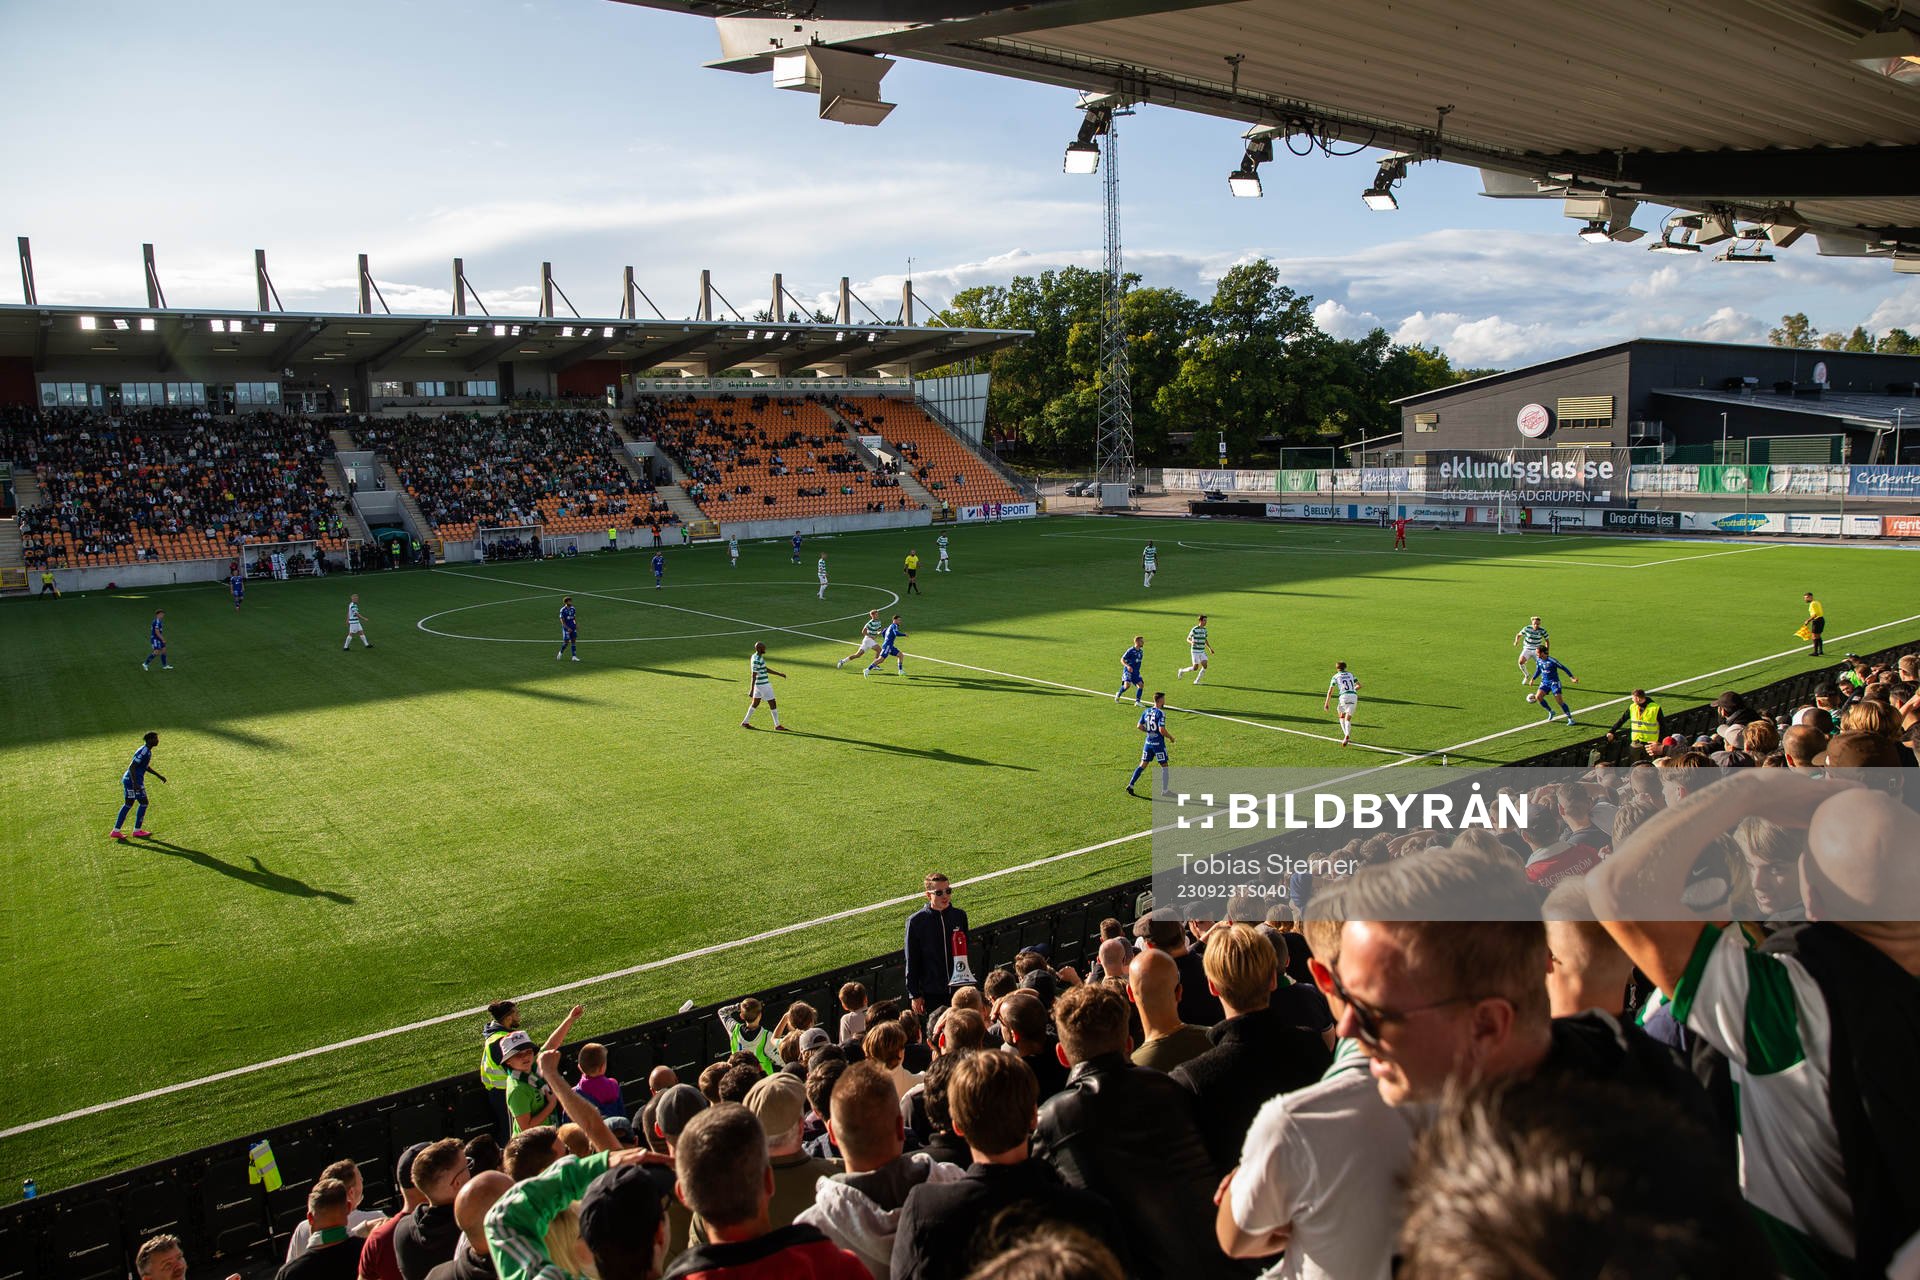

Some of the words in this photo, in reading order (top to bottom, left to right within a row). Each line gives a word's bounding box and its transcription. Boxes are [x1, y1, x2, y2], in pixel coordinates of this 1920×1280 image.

[1440, 456, 1613, 484] eklundsglas.se
[1442, 490, 1456, 500] EN
[1459, 490, 1479, 501] DEL
[1481, 490, 1497, 501] AV
[1498, 490, 1591, 502] FASADGRUPPEN
[1311, 507, 1340, 515] BELLEVUE
[1609, 512, 1627, 524] One
[1628, 513, 1639, 524] of
[1639, 513, 1656, 525] the
[1342, 679, 1354, 691] 31
[1145, 714, 1157, 731] 15
